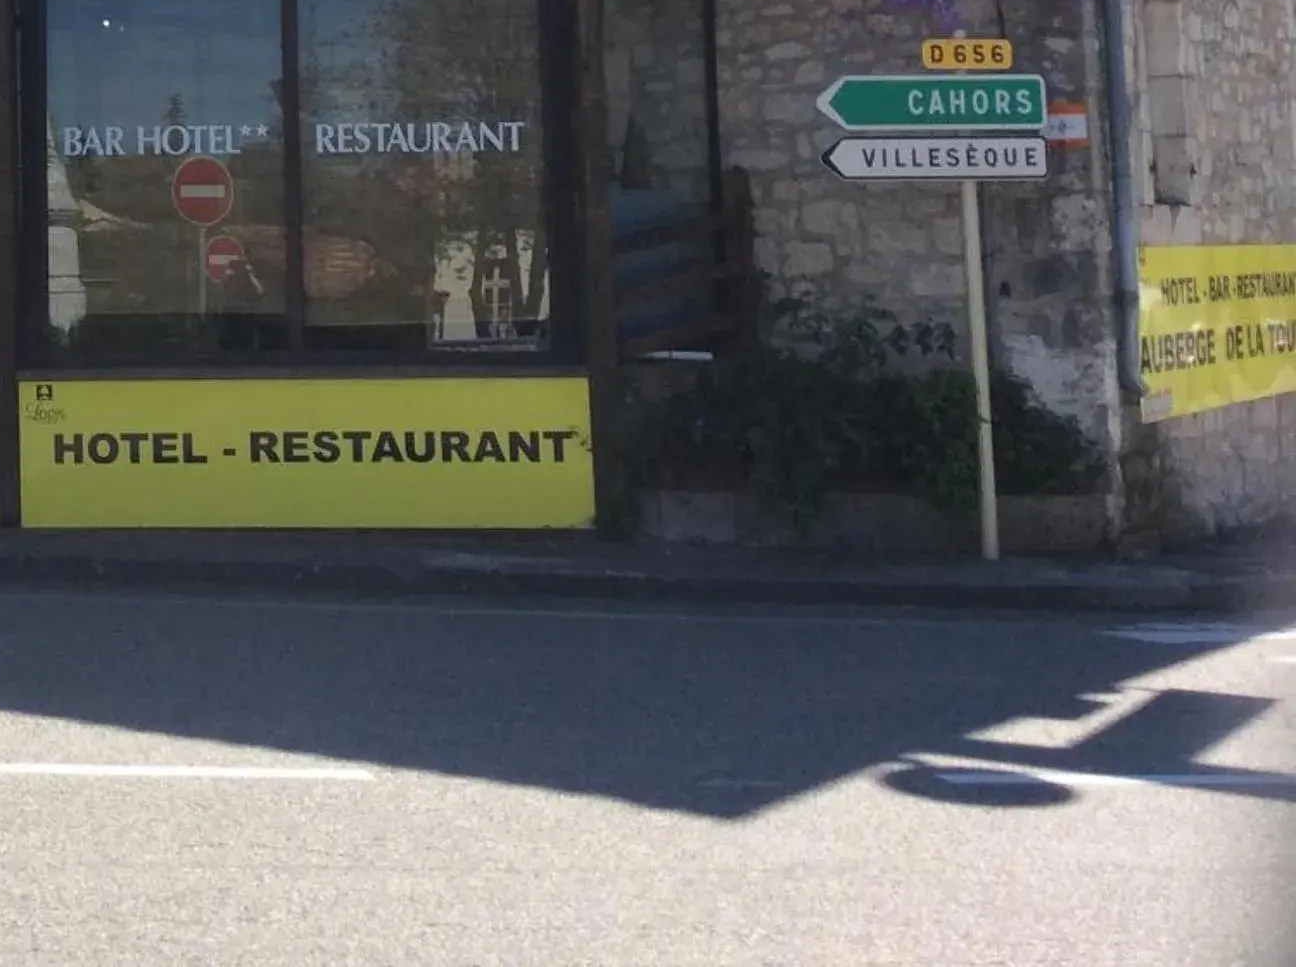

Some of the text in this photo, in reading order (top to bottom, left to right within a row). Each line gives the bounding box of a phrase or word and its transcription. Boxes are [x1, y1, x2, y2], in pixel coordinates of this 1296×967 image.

[930, 43, 1005, 63] D 656
[908, 89, 1033, 115] CAHORS
[62, 125, 125, 156] BAR
[315, 121, 525, 153] RESTAURANT
[862, 144, 1038, 168] VILLESÈQUE
[1160, 276, 1200, 306] HOTEL
[1208, 275, 1232, 302] BAR
[1140, 329, 1217, 374] AUBERGE
[1226, 324, 1245, 361] DE
[1247, 324, 1265, 358] LA
[54, 432, 208, 464] HOTEL
[250, 431, 577, 463] RESTAURANT
